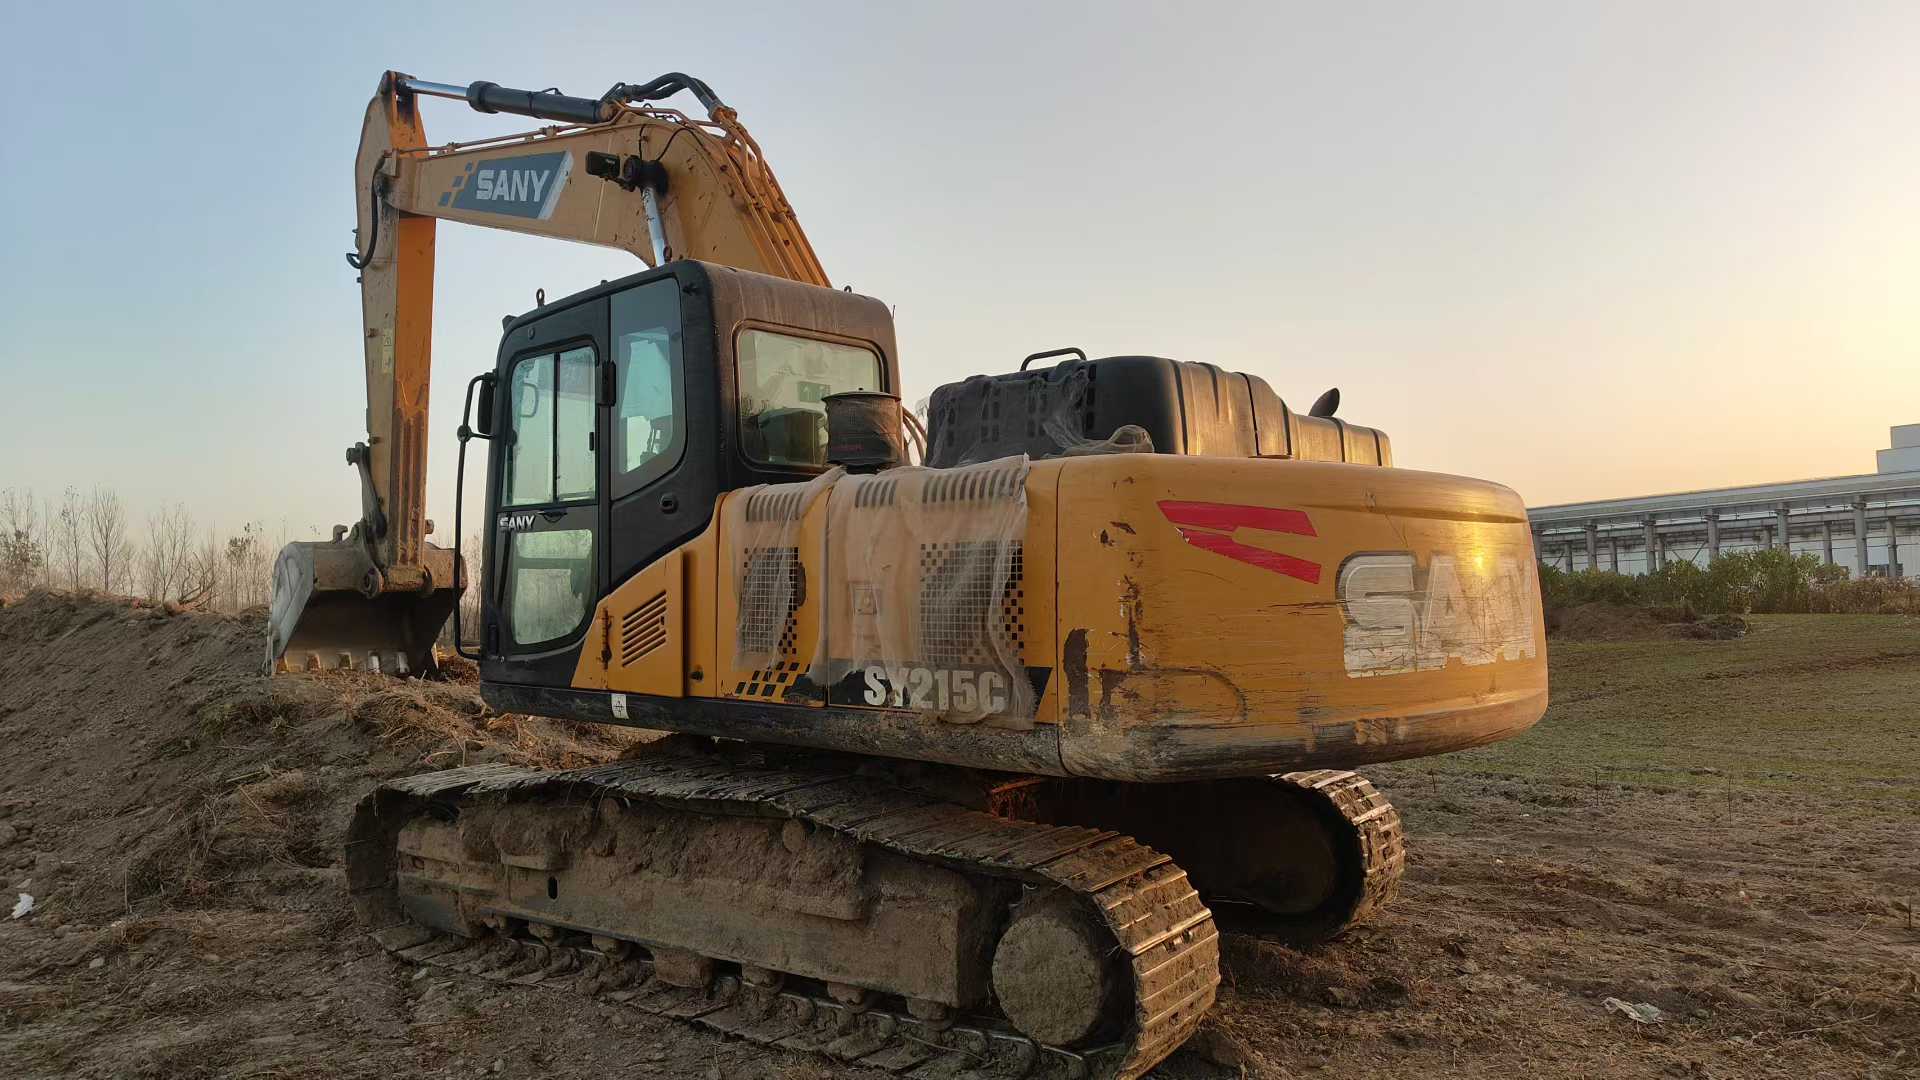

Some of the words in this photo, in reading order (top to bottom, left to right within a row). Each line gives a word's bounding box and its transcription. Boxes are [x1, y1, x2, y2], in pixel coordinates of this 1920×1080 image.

[476, 169, 550, 202] SANY
[500, 514, 535, 531] SANY
[864, 665, 1004, 714] SY215C
